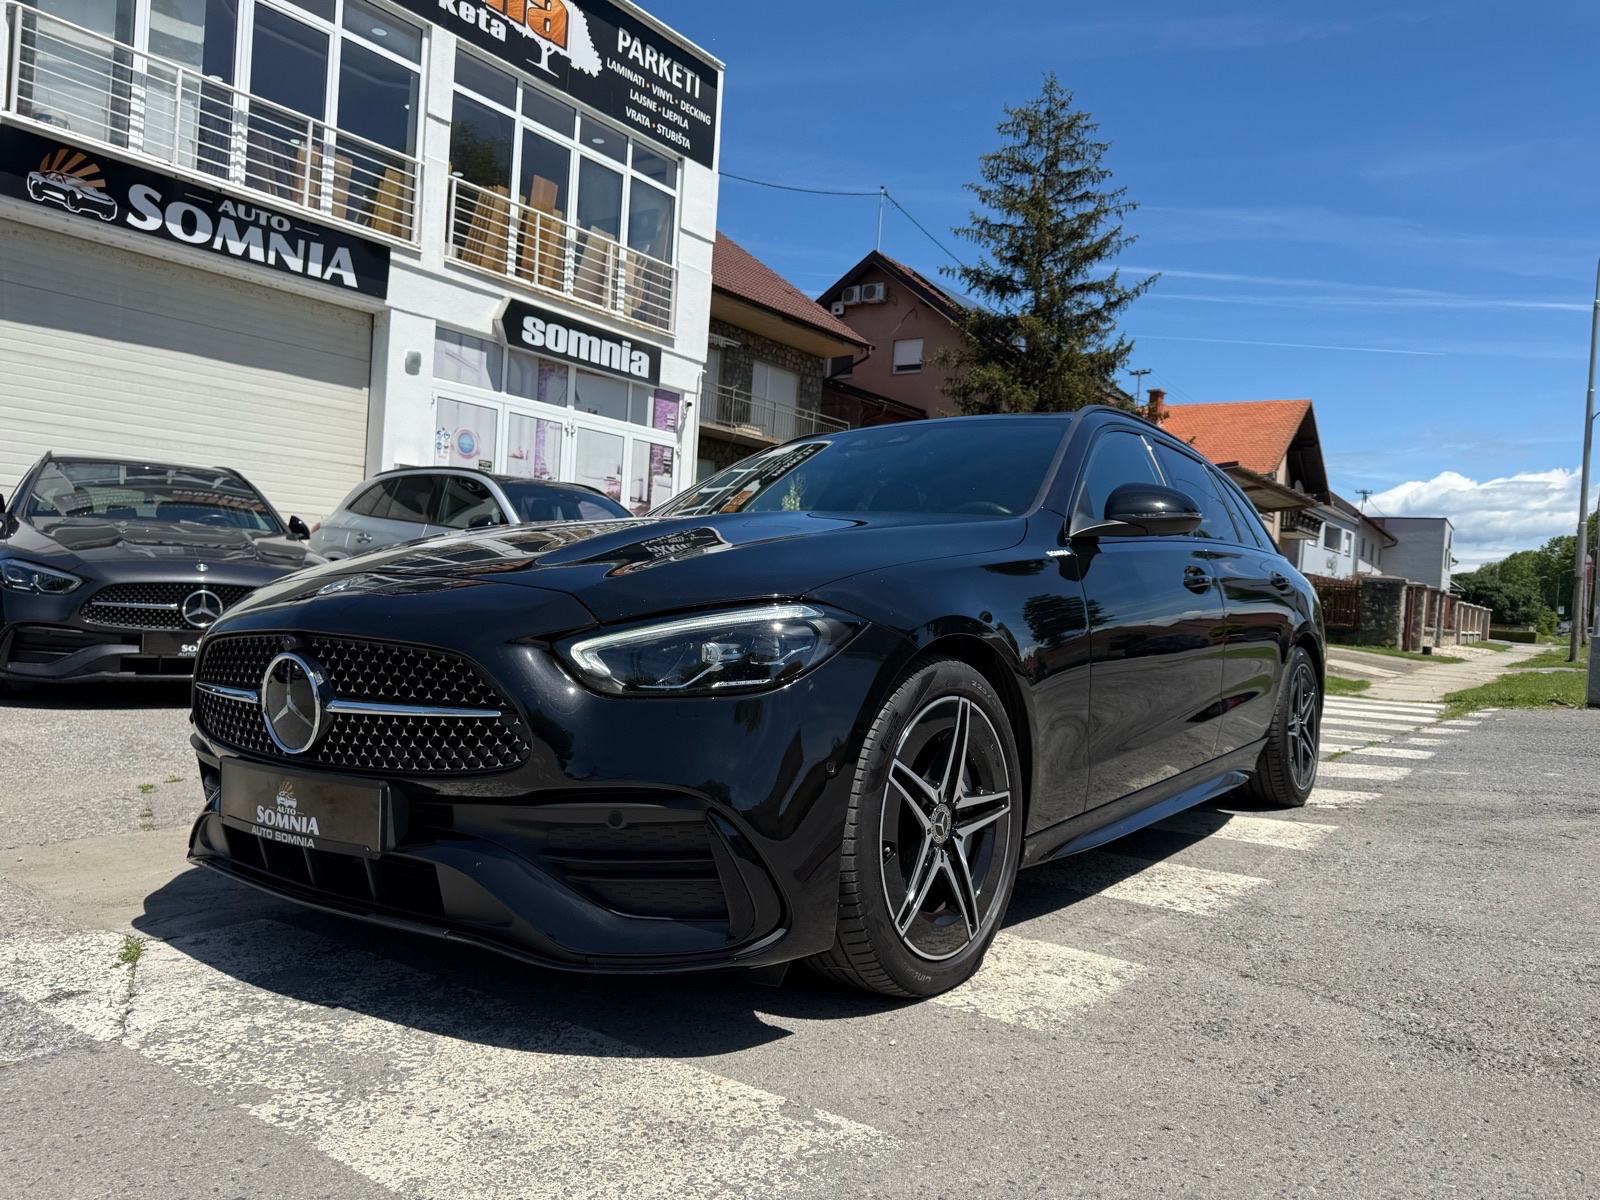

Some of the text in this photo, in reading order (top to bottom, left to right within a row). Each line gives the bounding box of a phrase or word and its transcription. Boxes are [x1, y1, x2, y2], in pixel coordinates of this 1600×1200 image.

[617, 27, 700, 99] PARKETI
[606, 57, 711, 126] LAMINATI VINYL DECKING
[630, 89, 689, 130] LAJSNE LJEPILA
[625, 106, 691, 150] VRATA STUBIŠTA
[126, 184, 358, 288] SOMNIA
[218, 200, 291, 232] AUTO
[521, 315, 650, 379] somnia
[256, 804, 320, 835] SOMNIA
[276, 806, 296, 815] AUTO
[251, 825, 315, 848] AUTO SOMNIA
